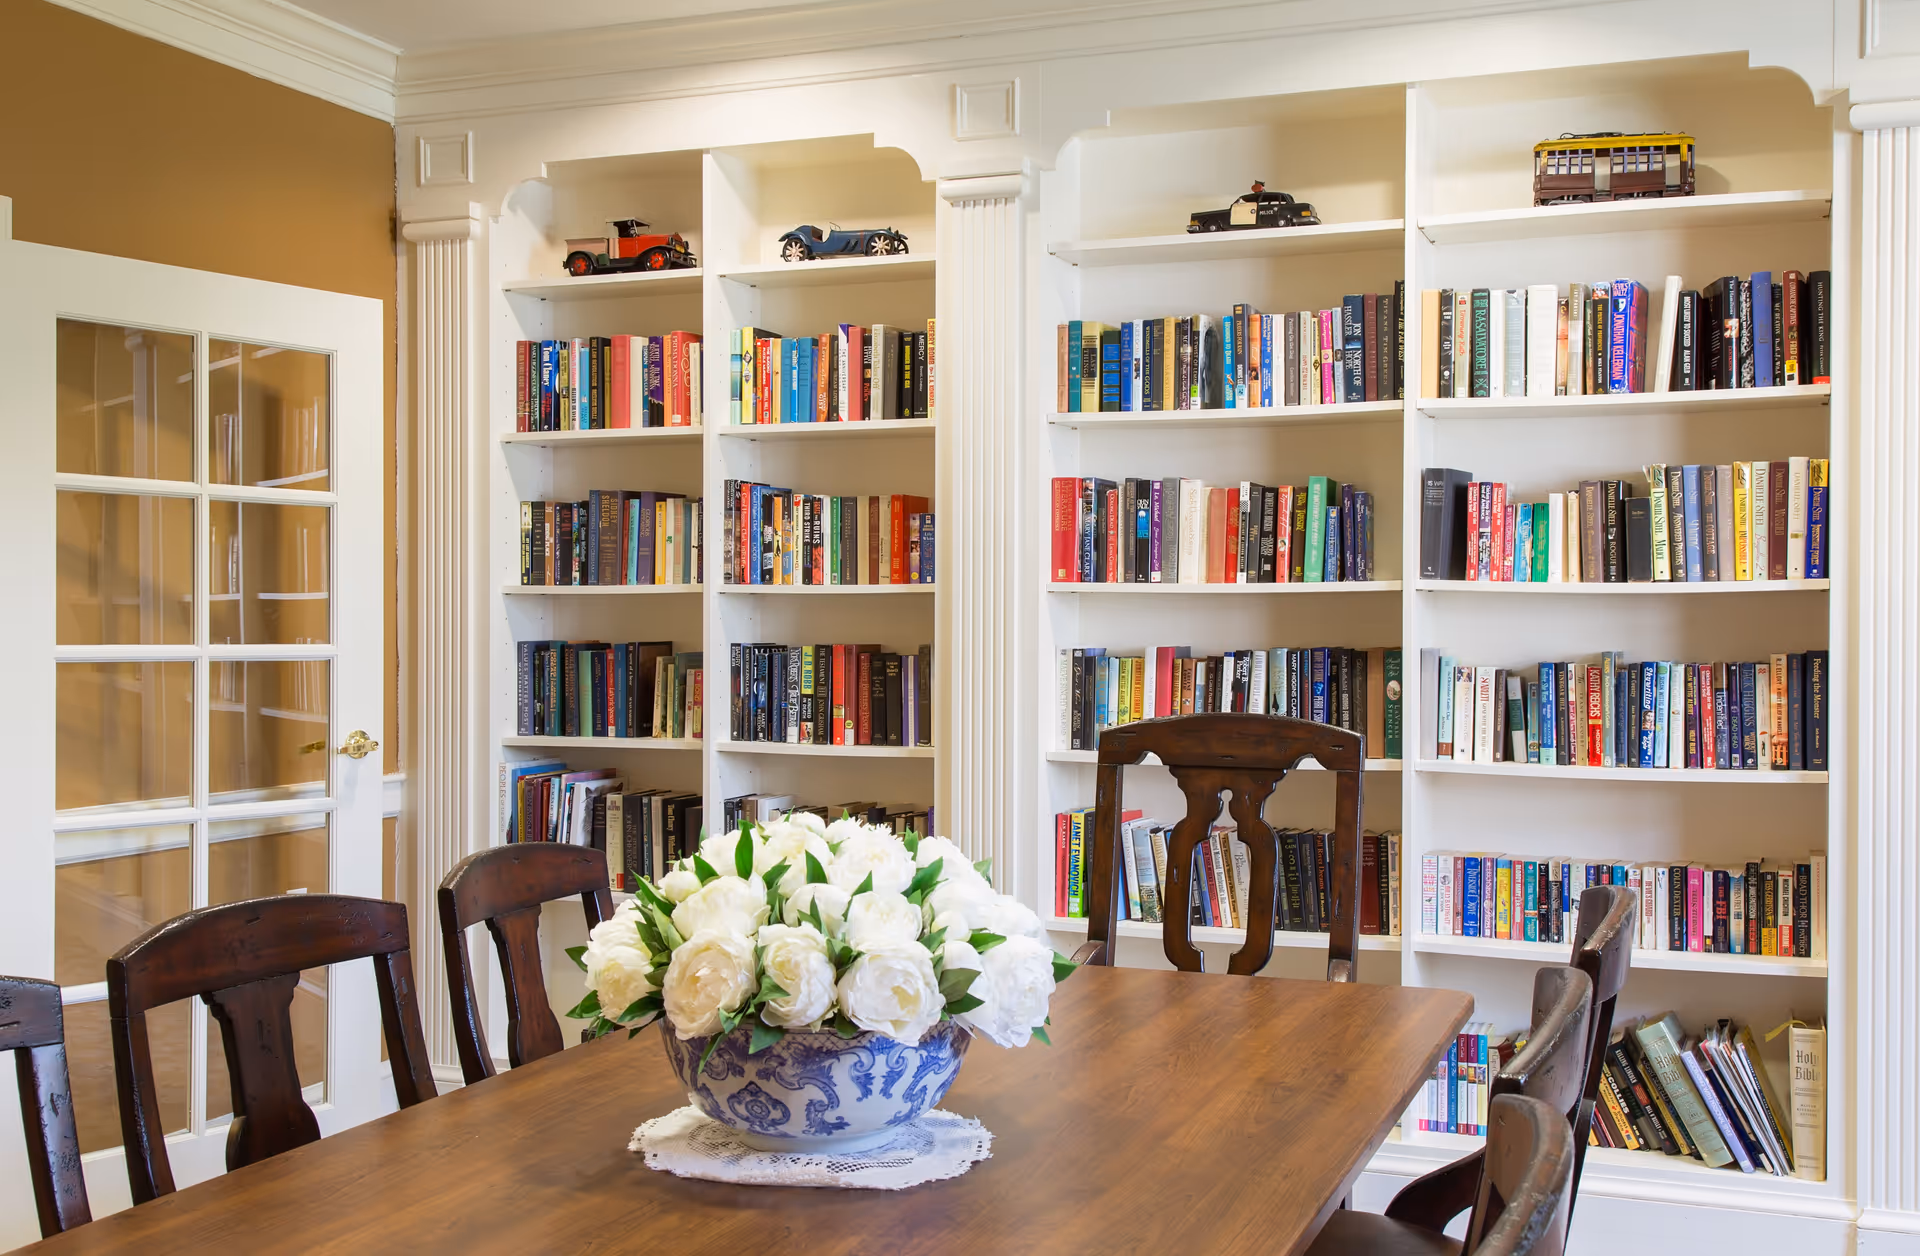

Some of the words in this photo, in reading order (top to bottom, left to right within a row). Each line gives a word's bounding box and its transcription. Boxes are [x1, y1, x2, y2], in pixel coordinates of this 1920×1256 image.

[1789, 282, 1797, 305] COMANCHE
[1344, 305, 1352, 336] HASSLER
[1353, 323, 1361, 336] JON
[1458, 310, 1466, 339] Drowning
[1613, 313, 1625, 344] JONATHAN
[543, 346, 552, 362] Tom
[1345, 350, 1353, 370] HOPE
[1353, 350, 1362, 375] NORTH
[1612, 345, 1625, 380] KELLERMAN
[541, 362, 552, 387] Clancy
[1354, 376, 1362, 386] OF
[1670, 471, 1681, 493] DANIELLE
[1755, 468, 1766, 504] DANIELLE
[1608, 483, 1616, 510] DANIELLE
[1653, 491, 1664, 516] DANIELLE
[1672, 492, 1682, 508] STEEL
[601, 494, 610, 527] SHELDON
[610, 498, 618, 524] SIDNEY
[1608, 509, 1616, 526] STEEL
[1755, 505, 1766, 527] STEEL
[1812, 507, 1822, 522] STEEL
[1654, 516, 1666, 535] STEEL
[1672, 512, 1683, 542] ANSWERED
[1655, 539, 1666, 560] MALICE
[1706, 524, 1715, 555] COTTAGE
[804, 652, 812, 660] J.
[1242, 656, 1250, 676] Robert
[804, 669, 812, 690] ROBB
[1241, 676, 1248, 684] B.
[1590, 669, 1600, 691] KATHY
[1743, 668, 1753, 688] JACK
[1813, 658, 1821, 682] Feeding
[1644, 666, 1653, 710] Skywriting
[1813, 683, 1821, 693] the
[817, 699, 825, 712] JOHN
[1590, 692, 1601, 717] REICHS
[1716, 692, 1727, 730] Unidentified
[1743, 690, 1754, 727] HIGGINS
[1813, 693, 1821, 719] Monster
[667, 804, 675, 816] Tom
[666, 816, 675, 831] Clancy
[1072, 819, 1081, 848] JANET
[668, 835, 676, 854] Without
[1070, 849, 1080, 896] EVANOVICH
[1467, 868, 1478, 896] RIVERSIDE
[1673, 868, 1681, 890] COLIN
[1765, 880, 1773, 890] TESS
[1782, 878, 1790, 896] MICHAEL
[1799, 875, 1808, 896] BRAD
[1467, 896, 1478, 916] DRIVE
[1673, 890, 1681, 916] DEXTER
[1716, 900, 1728, 920] FBI
[1782, 896, 1790, 916] CRICHTON
[1799, 897, 1807, 919] THOR
[1798, 928, 1806, 956] PATRIOT
[1615, 1049, 1628, 1066] KILLING
[1623, 1066, 1638, 1084] LINCOLN
[1795, 1049, 1820, 1067] Holy
[1607, 1076, 1630, 1114] COLLIES
[1645, 1105, 1653, 1114] BILL
